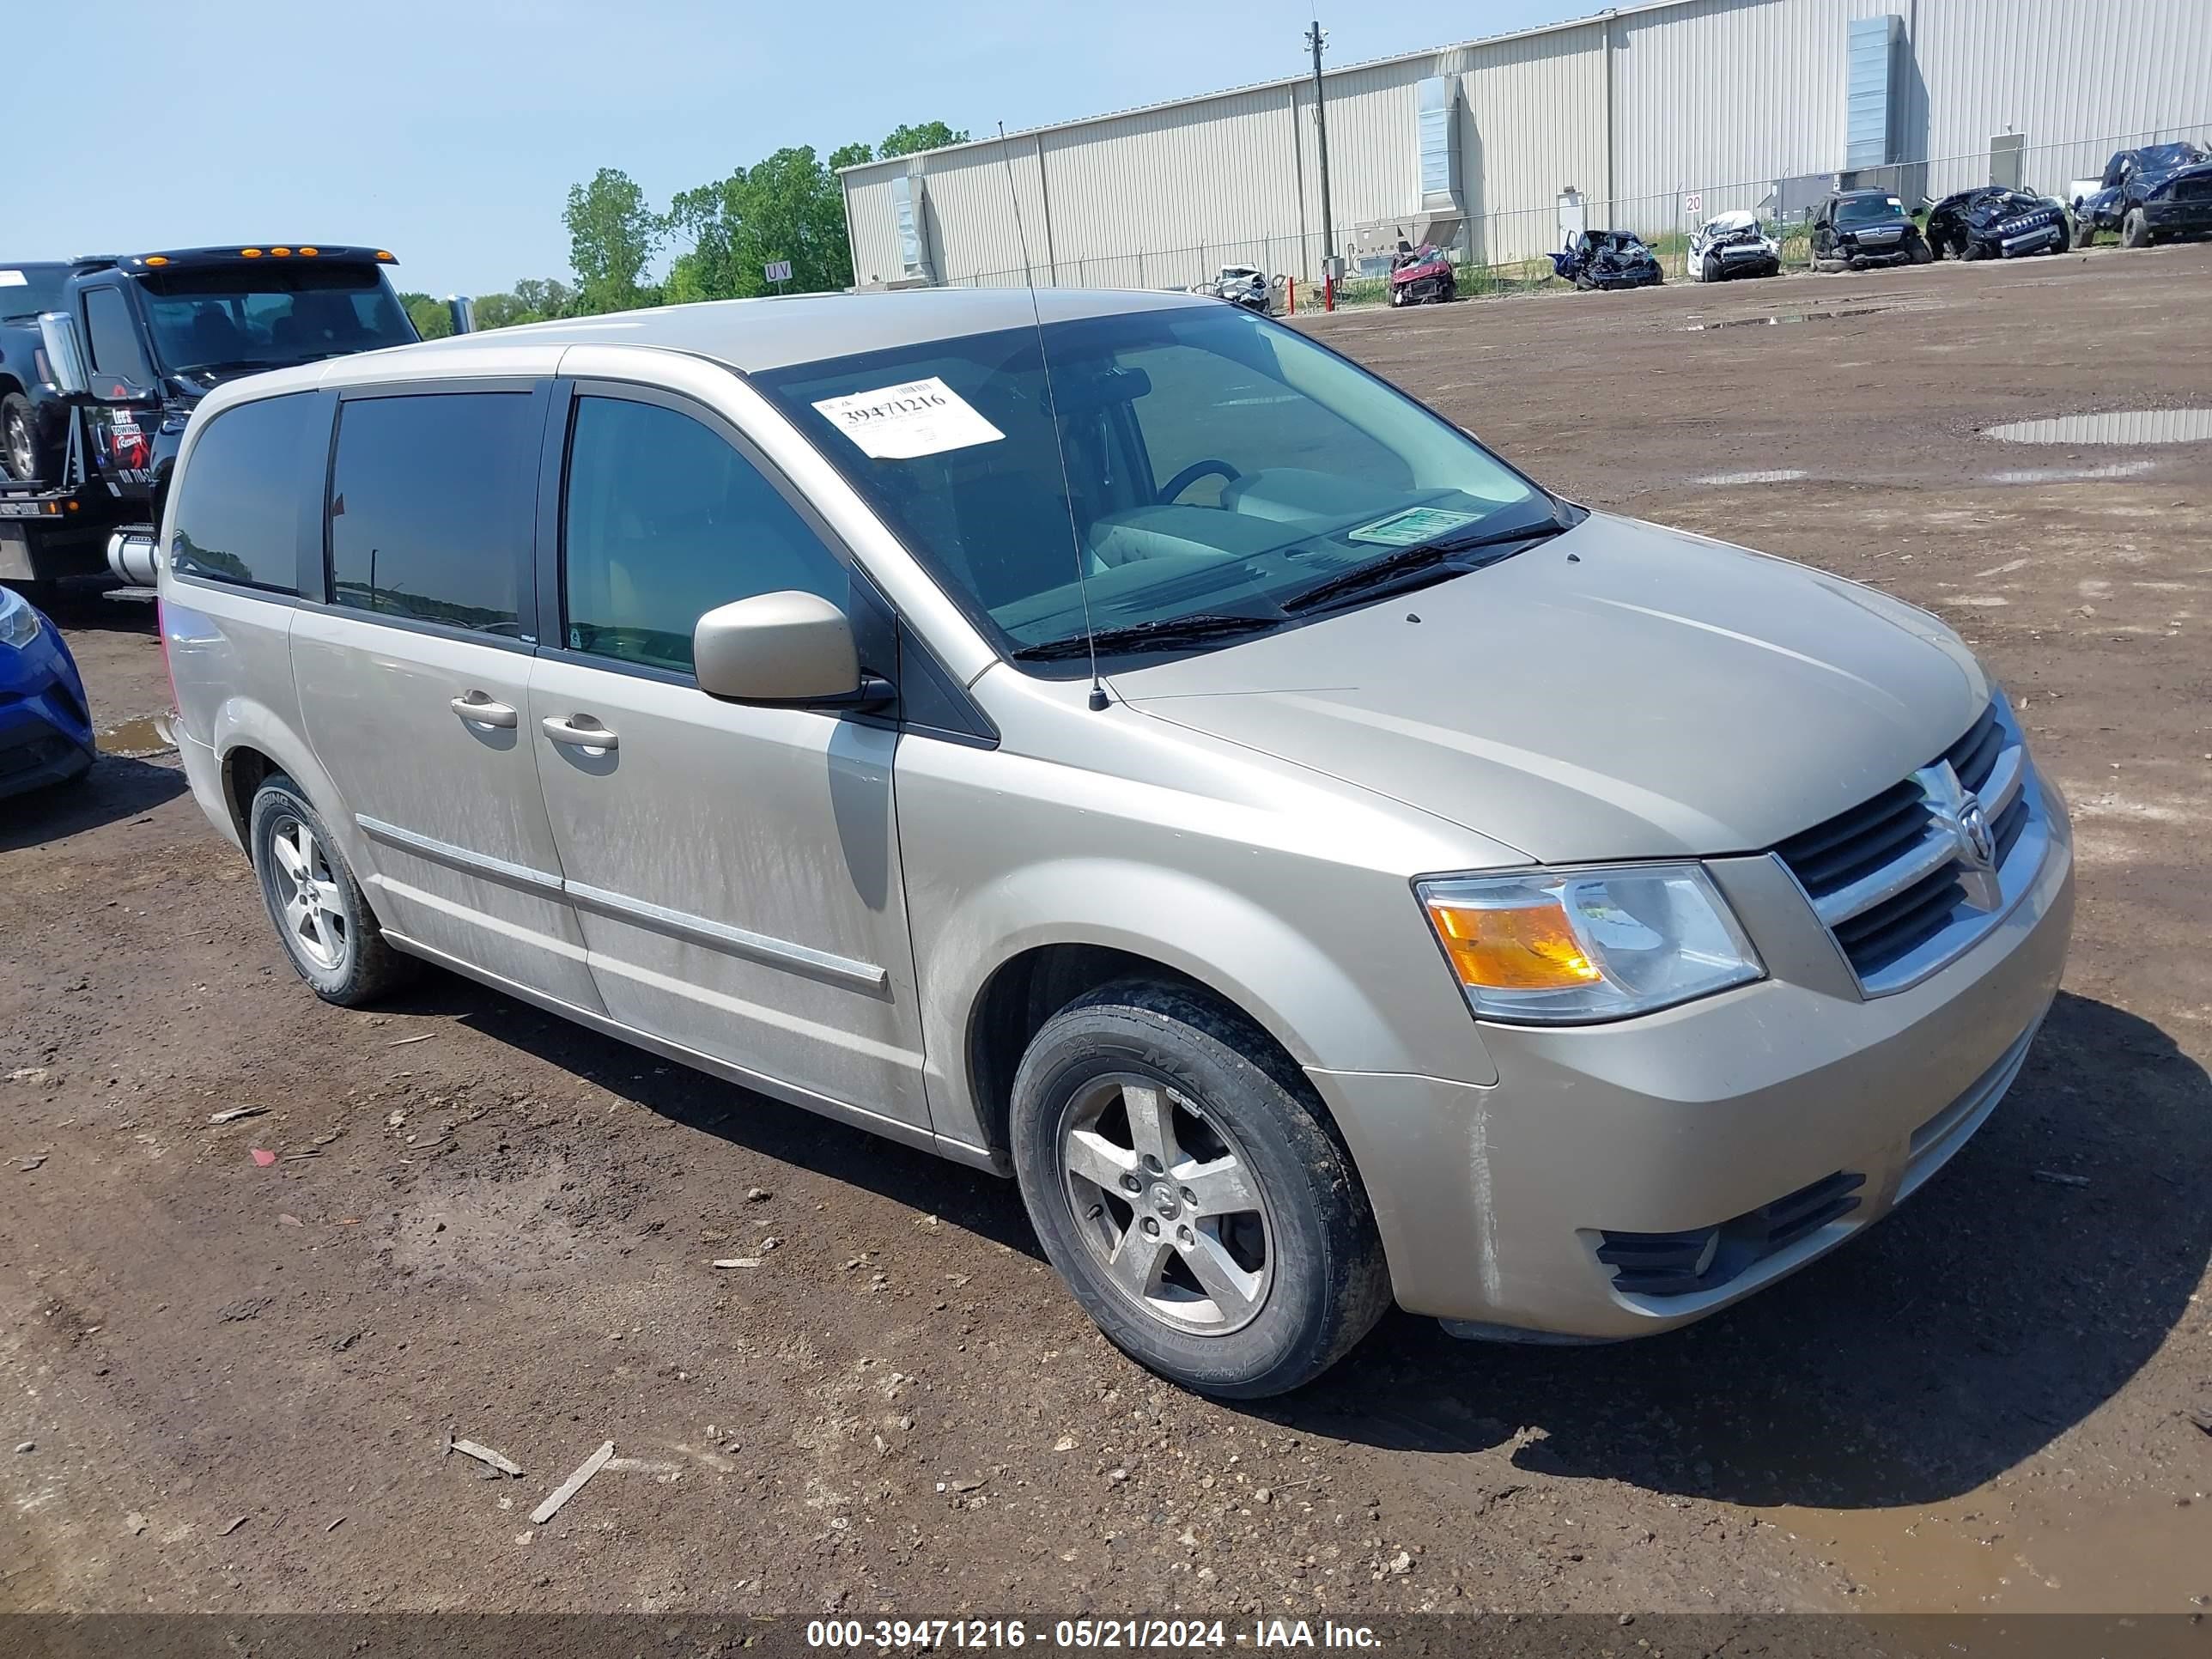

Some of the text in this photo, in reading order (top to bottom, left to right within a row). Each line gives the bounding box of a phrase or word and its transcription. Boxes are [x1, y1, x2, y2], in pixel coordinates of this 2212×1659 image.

[1687, 197, 1700, 210] 20
[842, 394, 946, 424] 39471216
[111, 424, 141, 435] TOWING
